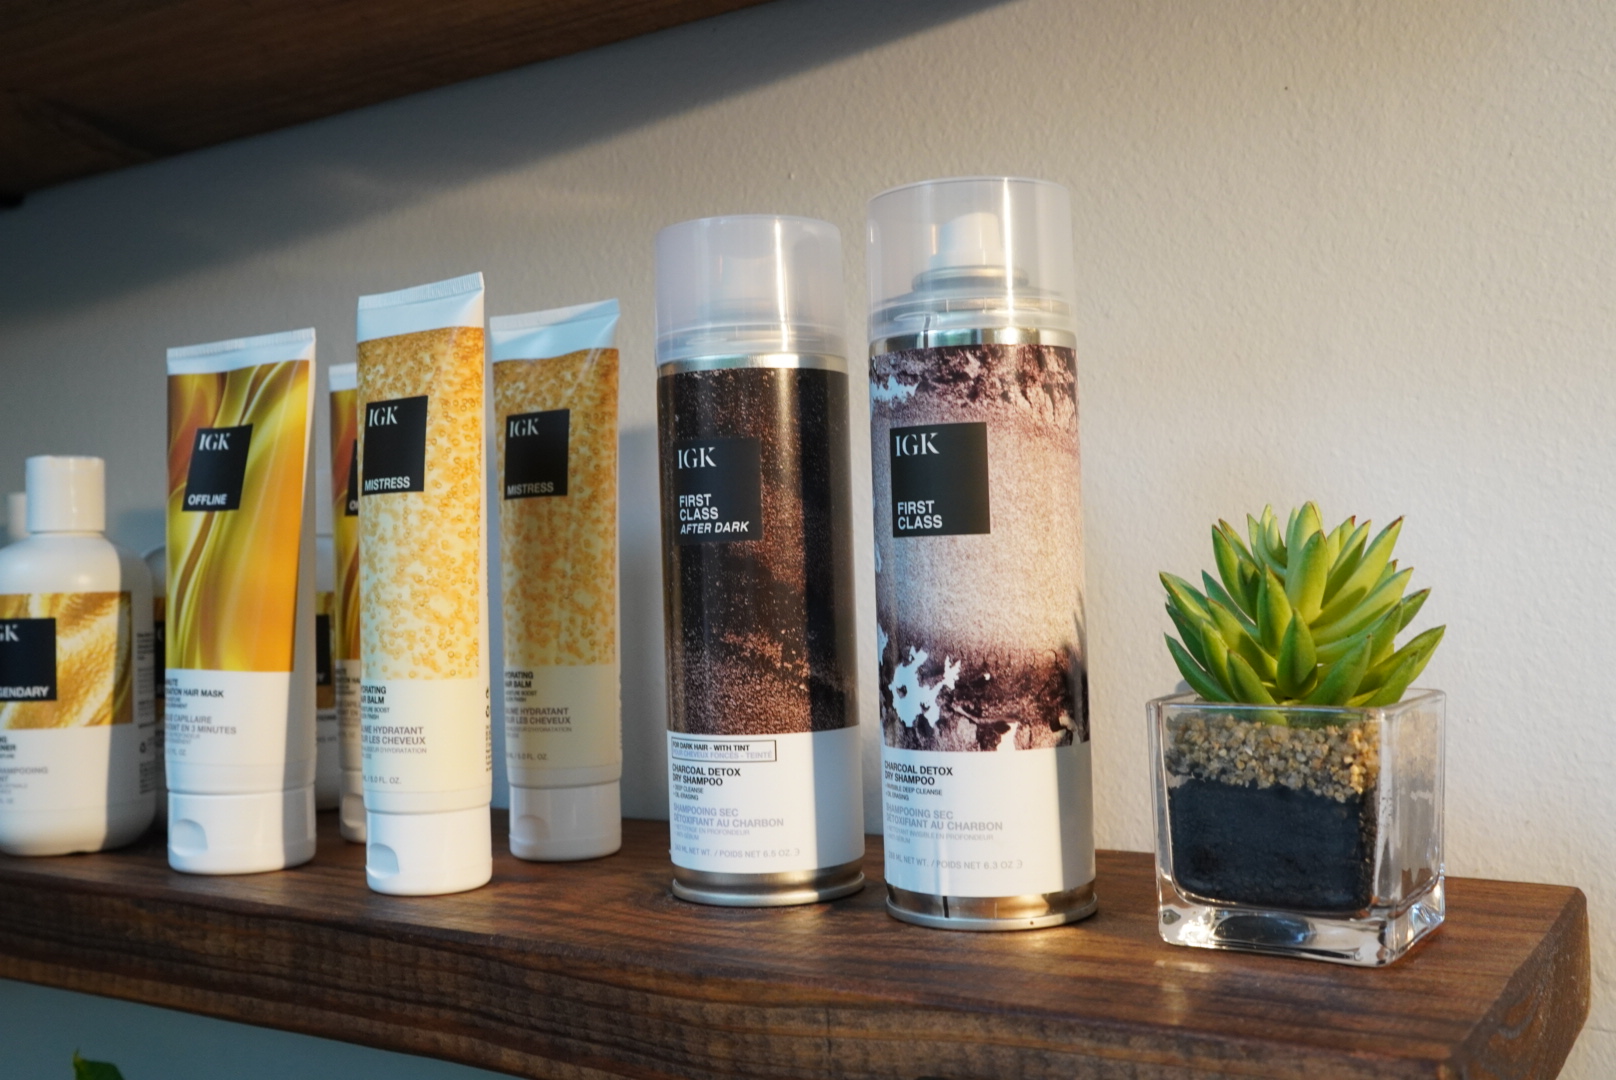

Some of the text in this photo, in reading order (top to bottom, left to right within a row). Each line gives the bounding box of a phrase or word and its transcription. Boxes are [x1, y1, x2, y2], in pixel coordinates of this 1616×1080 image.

[369, 406, 398, 427] IGK
[509, 418, 539, 438] IGK
[199, 432, 231, 451] IGK
[895, 432, 940, 457] IGK
[678, 446, 717, 469] IGK
[364, 476, 410, 492] MISTRESS
[507, 482, 554, 496] MISTRESS
[188, 494, 227, 505] OFFLINE
[679, 493, 712, 508] FIRST
[679, 506, 719, 522] CLASS
[897, 500, 935, 515] FIRST
[680, 521, 750, 535] AFTER DARK
[897, 514, 943, 530] CLASS
[200, 689, 224, 699] MASK
[367, 695, 385, 705] BALM
[520, 708, 569, 716] HYDRATANT
[529, 717, 572, 725] CHEVEUX
[197, 726, 237, 735] MINUTES
[373, 726, 424, 735] HYDRATANT
[381, 737, 426, 745] CHEVEUX
[680, 742, 693, 750] DARK
[694, 743, 708, 751] HAIR
[713, 744, 732, 752] WITH
[734, 744, 750, 752] TINT
[684, 750, 708, 759] CHEVEUX
[672, 763, 741, 778] CHARCOAL DETOX
[884, 759, 953, 777] CHARCOAL DETOX
[672, 773, 723, 787] DRY SHAMPOO
[884, 770, 936, 786] DRY SHAMPOO
[915, 787, 942, 796] CLEANSE
[673, 802, 739, 817] SHAMPOOING SEC
[885, 802, 954, 820] SHAMPOOING SEC
[716, 818, 730, 828] AU
[732, 818, 784, 828] CHARBON
[930, 820, 944, 830] AU
[946, 821, 1004, 831] CHARBON
[719, 848, 743, 858] POIDS
[744, 849, 761, 858] NET
[936, 859, 961, 869] POIDS
[963, 861, 981, 870] NET
